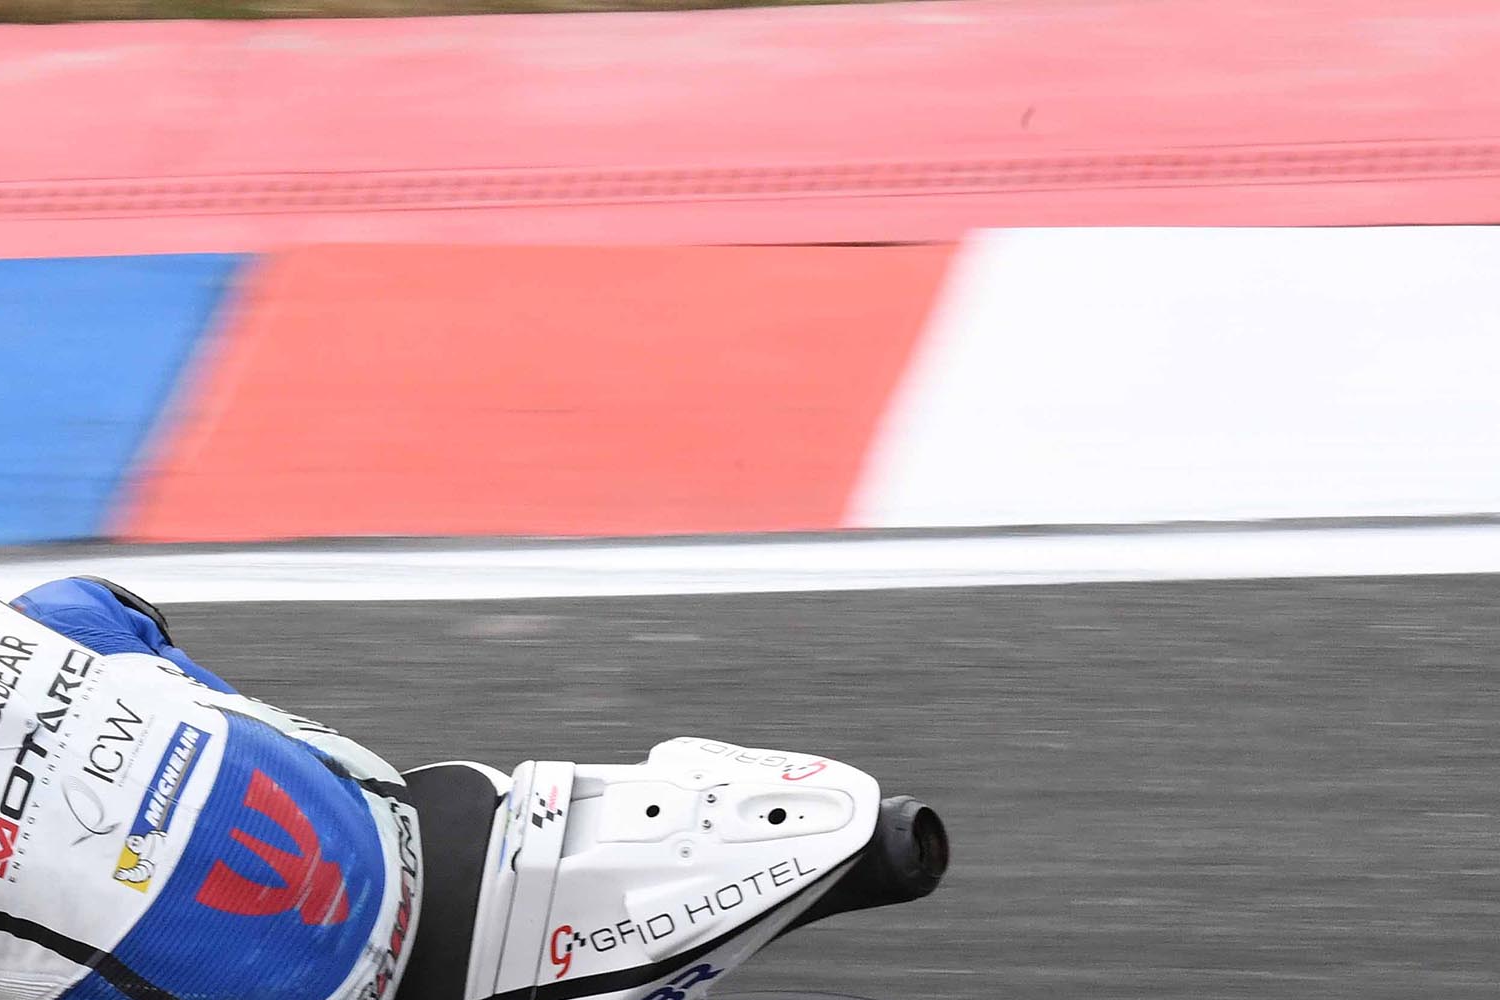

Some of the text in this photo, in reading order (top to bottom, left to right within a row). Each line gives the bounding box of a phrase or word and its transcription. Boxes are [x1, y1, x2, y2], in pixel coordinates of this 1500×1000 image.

[83, 698, 143, 784] ICW
[143, 726, 201, 828] MICHELIN
[683, 856, 818, 925] HOTEL
